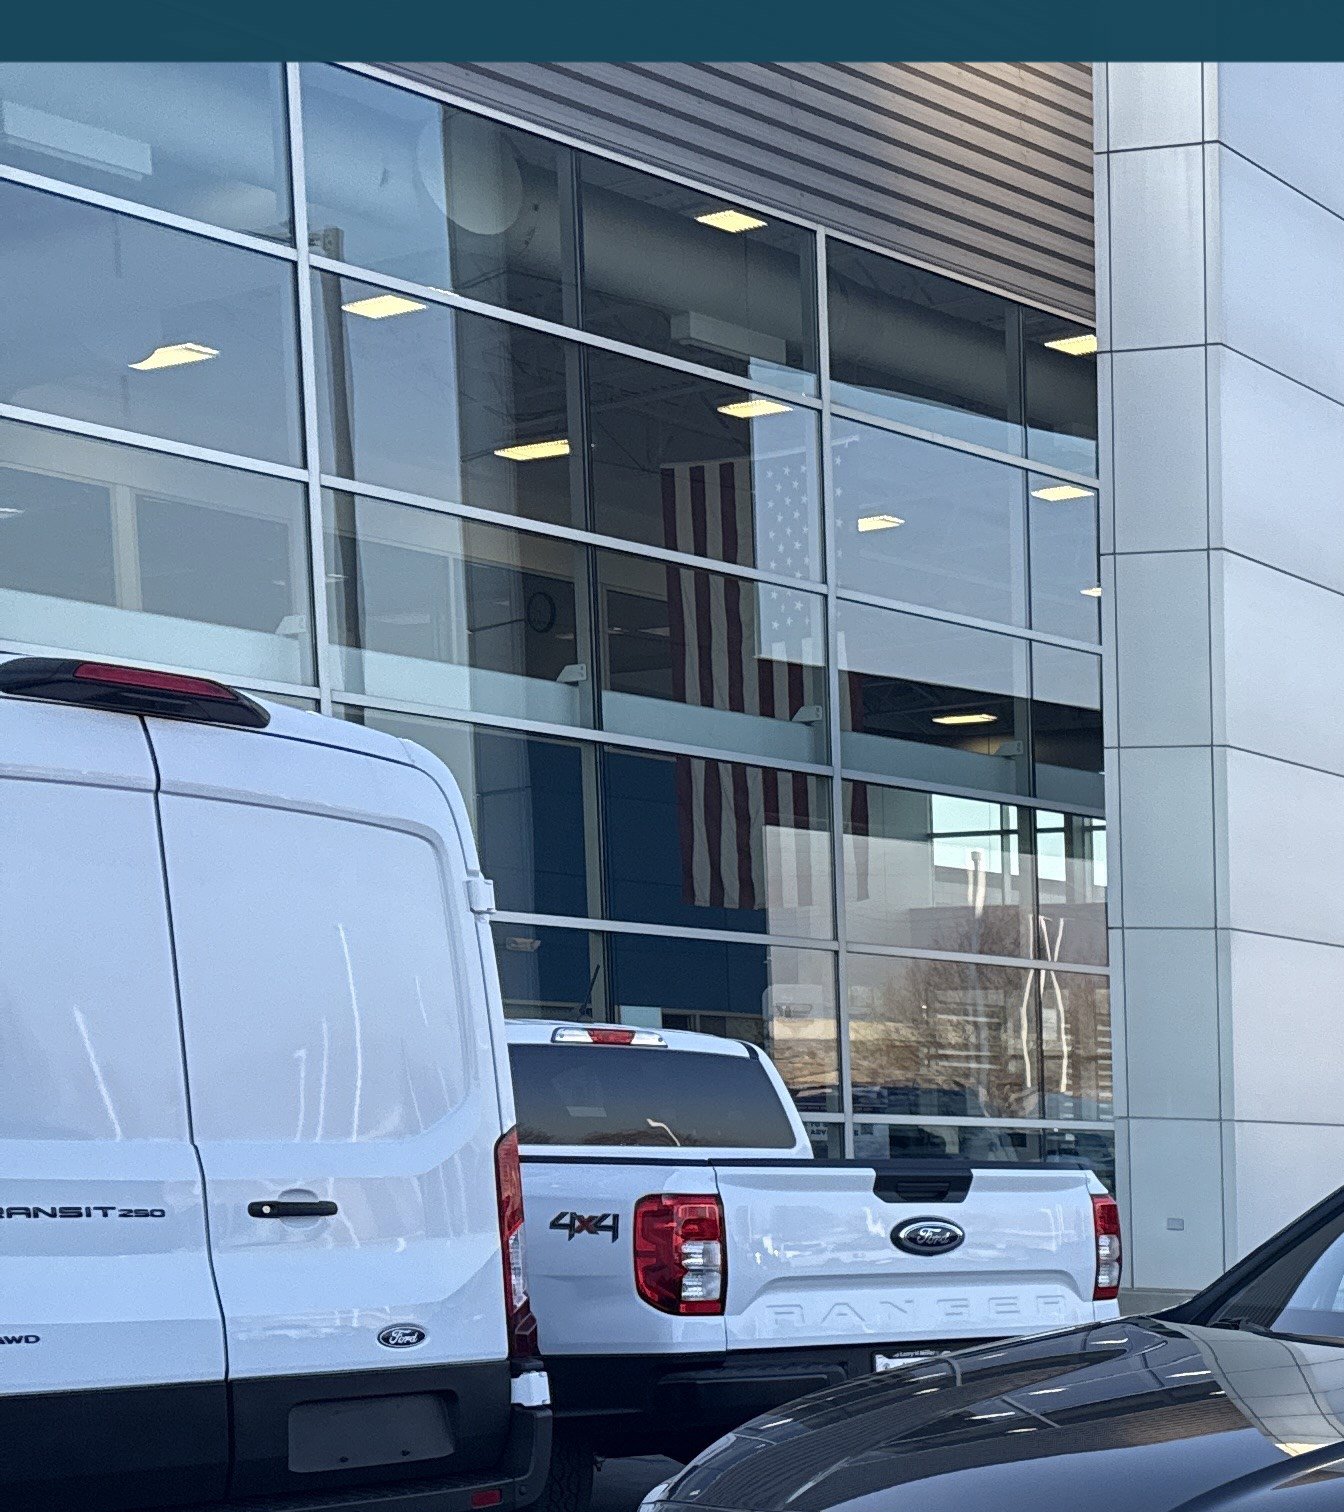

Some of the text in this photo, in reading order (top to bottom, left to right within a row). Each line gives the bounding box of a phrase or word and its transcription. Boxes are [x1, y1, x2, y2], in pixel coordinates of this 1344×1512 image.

[0, 1206, 166, 1218] ANSIT 250
[765, 1294, 1070, 1330] RANGER
